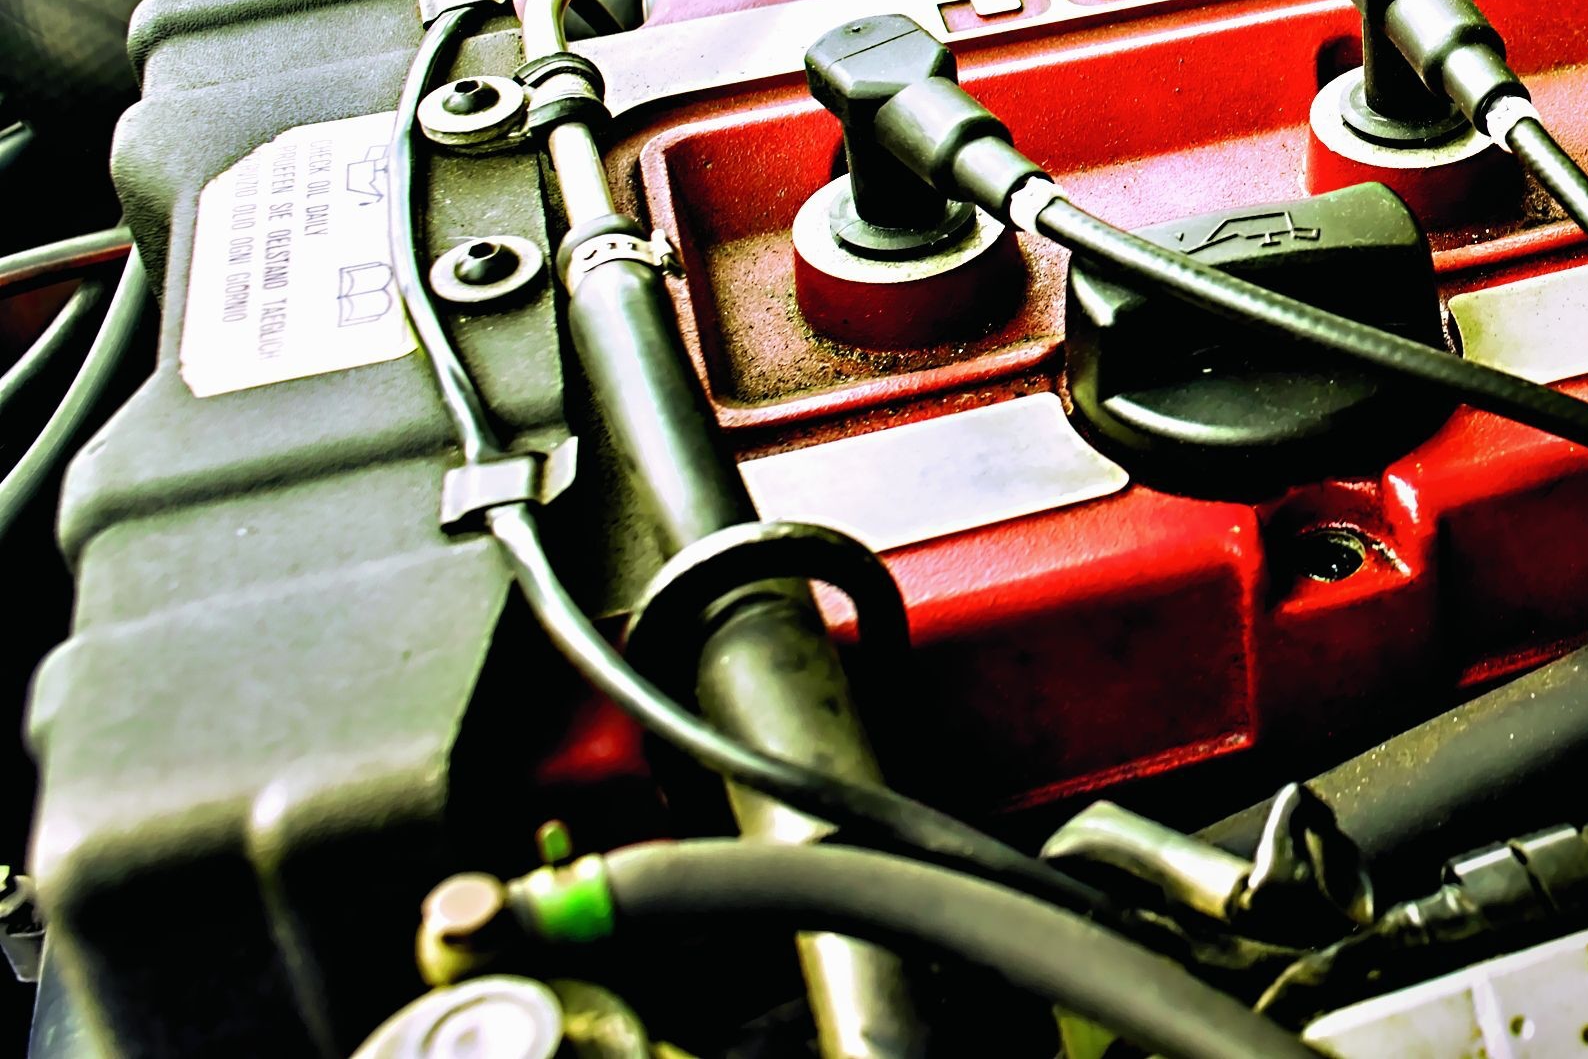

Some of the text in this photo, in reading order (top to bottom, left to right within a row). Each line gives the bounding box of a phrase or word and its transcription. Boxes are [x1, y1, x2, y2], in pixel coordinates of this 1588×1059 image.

[304, 140, 332, 237] CHECK OIL DAILY
[231, 204, 256, 230] OLIO
[269, 202, 293, 221] SIE
[228, 237, 254, 265] OGNI
[263, 229, 291, 290] OELSTAND
[259, 298, 287, 359] TAEGLICH
